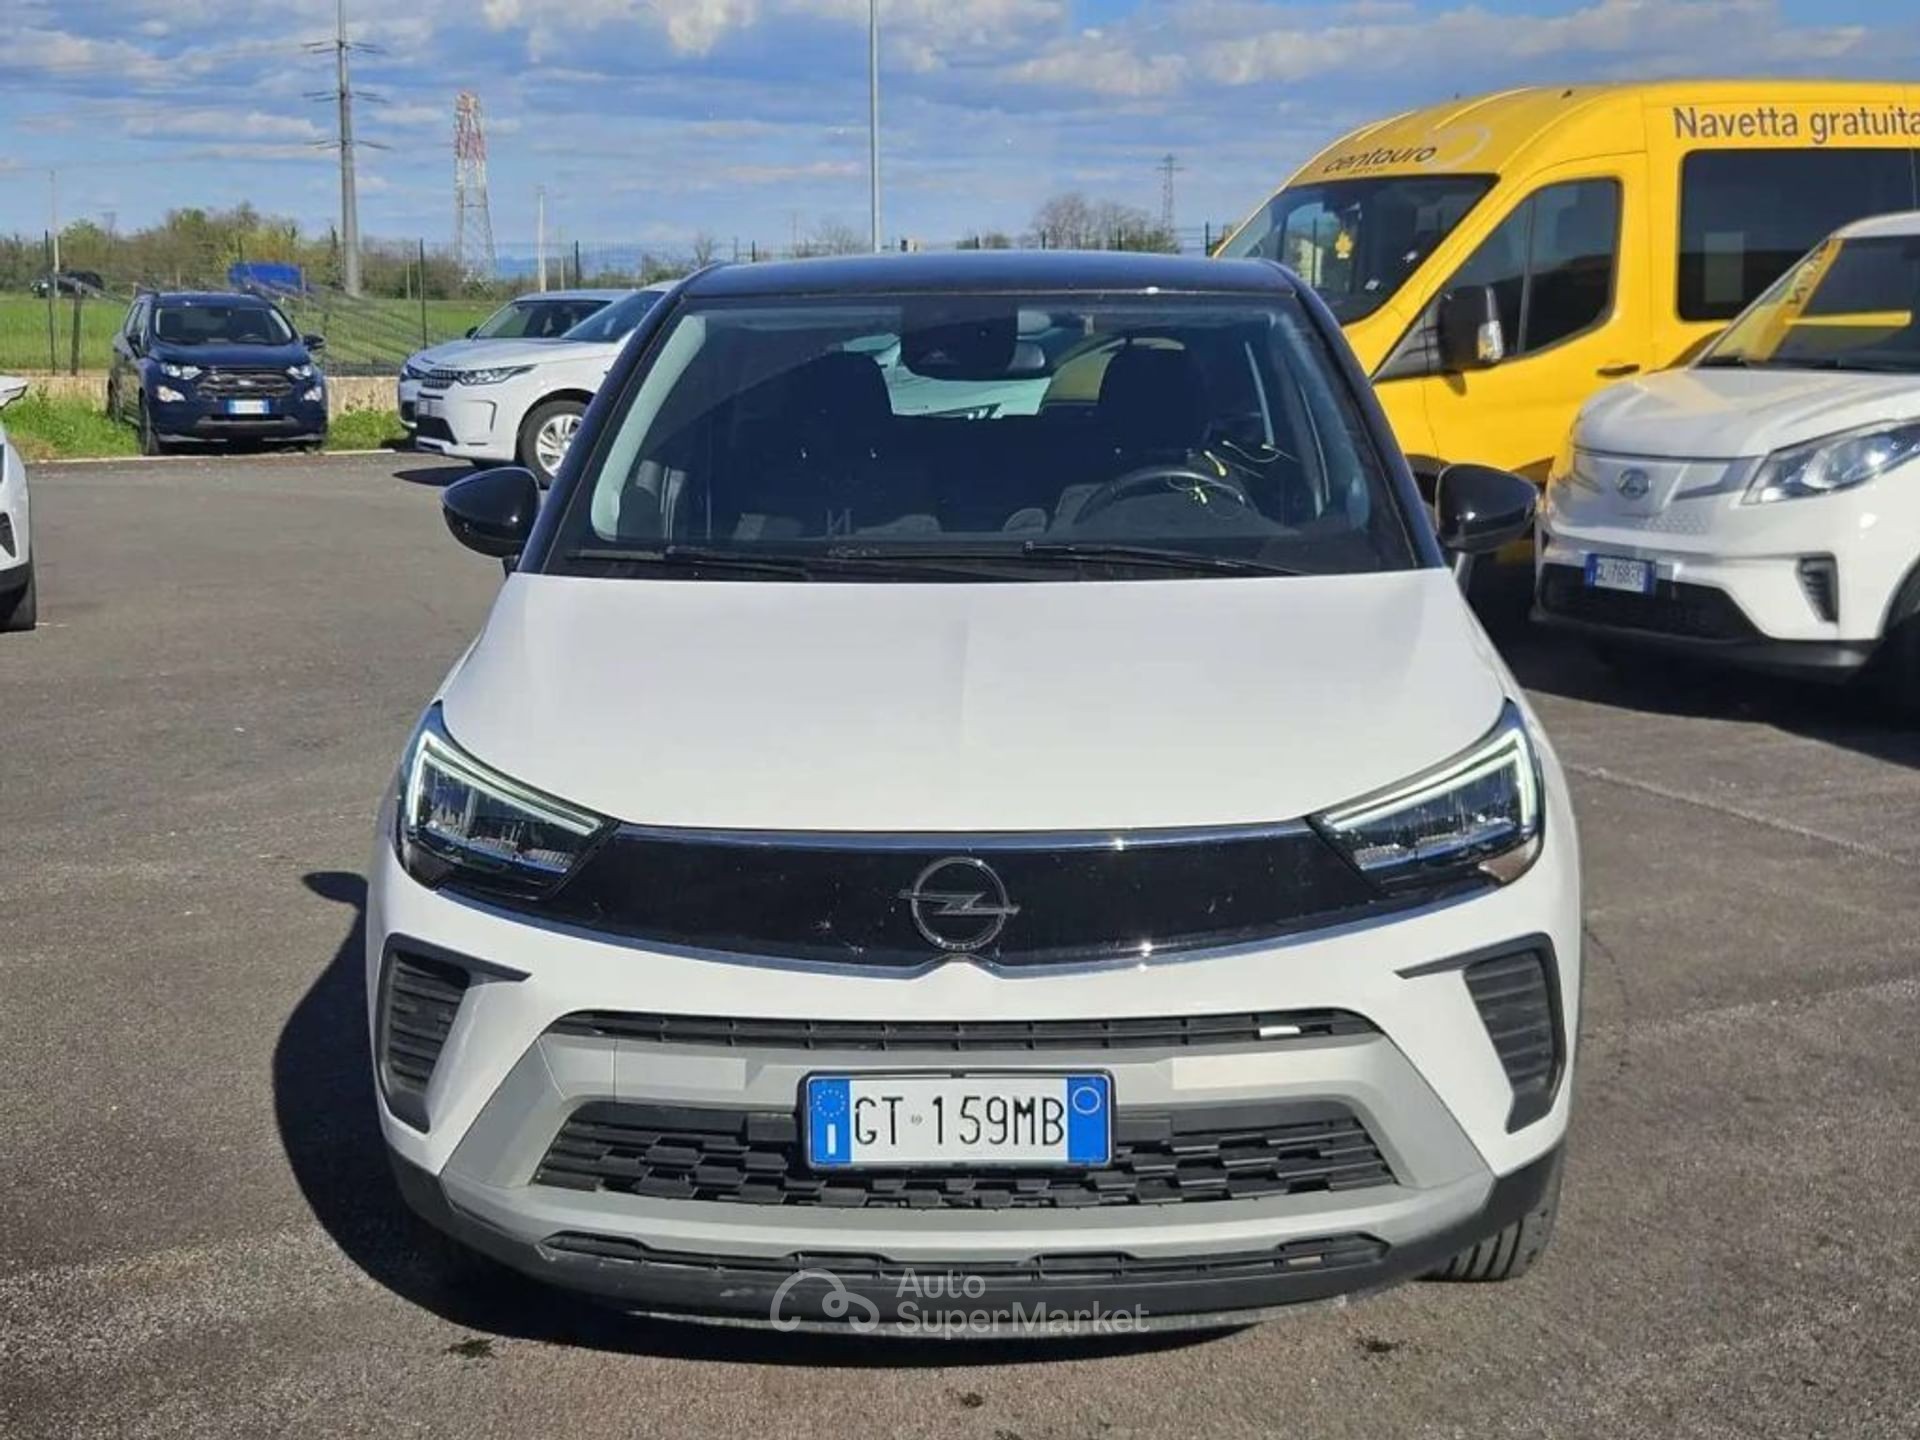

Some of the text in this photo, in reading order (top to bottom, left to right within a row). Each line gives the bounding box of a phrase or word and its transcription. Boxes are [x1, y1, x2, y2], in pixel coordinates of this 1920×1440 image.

[1673, 105, 1920, 145] Navetta gratuita
[1322, 147, 1437, 174] centauro
